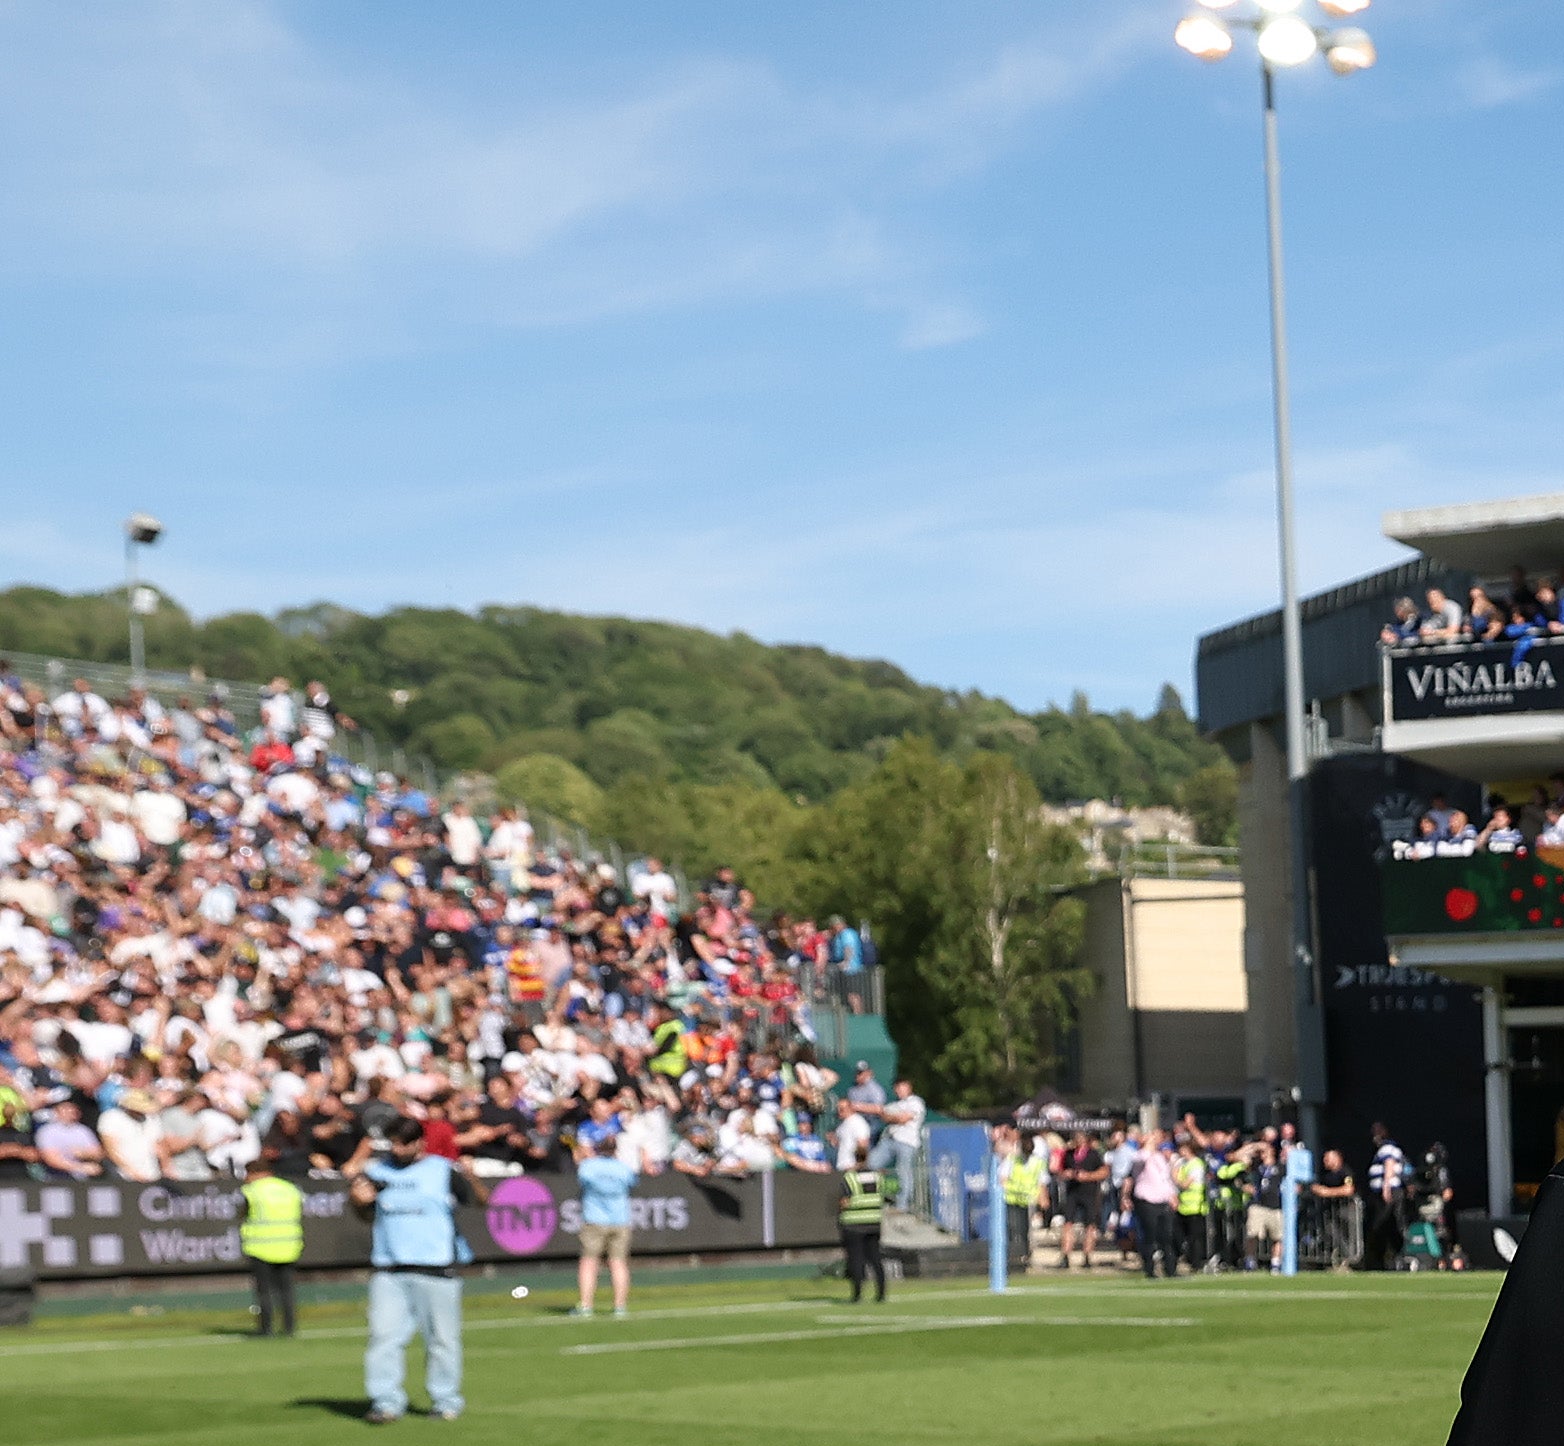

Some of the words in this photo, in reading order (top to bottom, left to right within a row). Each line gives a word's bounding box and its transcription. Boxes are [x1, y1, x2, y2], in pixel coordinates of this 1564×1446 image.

[1406, 659, 1558, 701] VIÑALBA
[558, 1196, 689, 1231] SRTS
[140, 1228, 244, 1264] Ward
